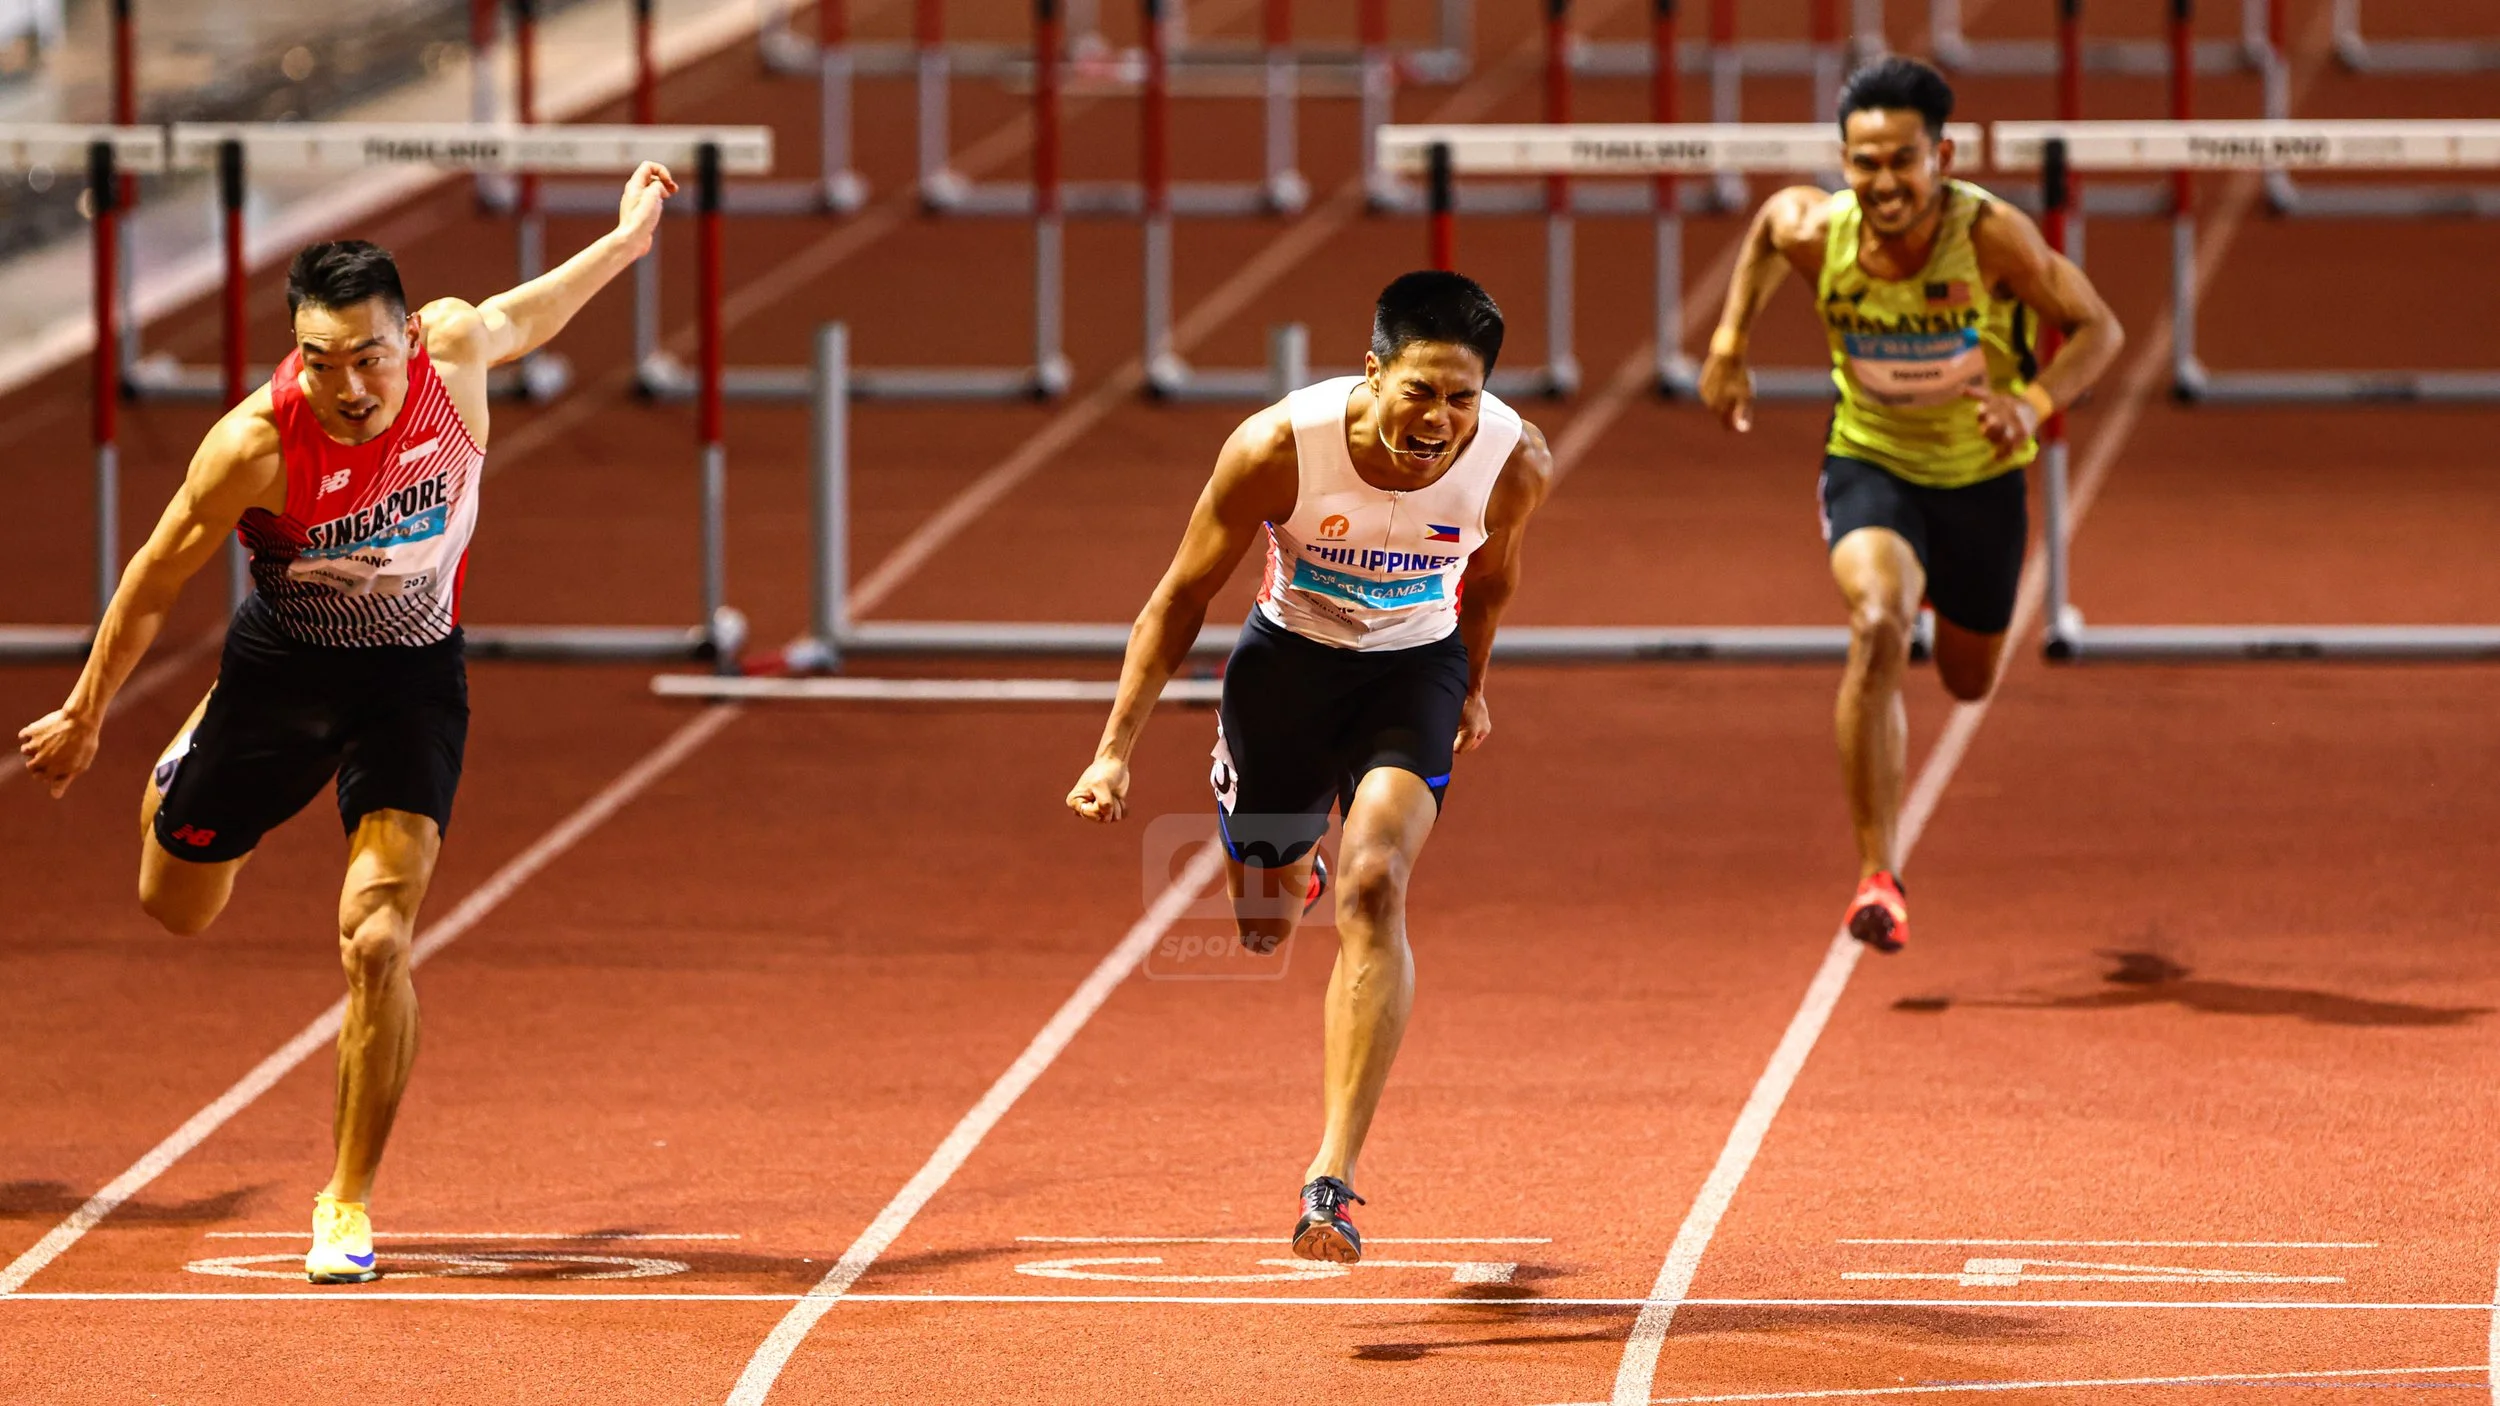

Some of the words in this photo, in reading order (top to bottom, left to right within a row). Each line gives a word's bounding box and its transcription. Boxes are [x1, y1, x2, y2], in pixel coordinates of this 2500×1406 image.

[306, 470, 448, 549] SINGAPORE
[403, 575, 428, 589] 207
[1370, 580, 1428, 599] GAMES
